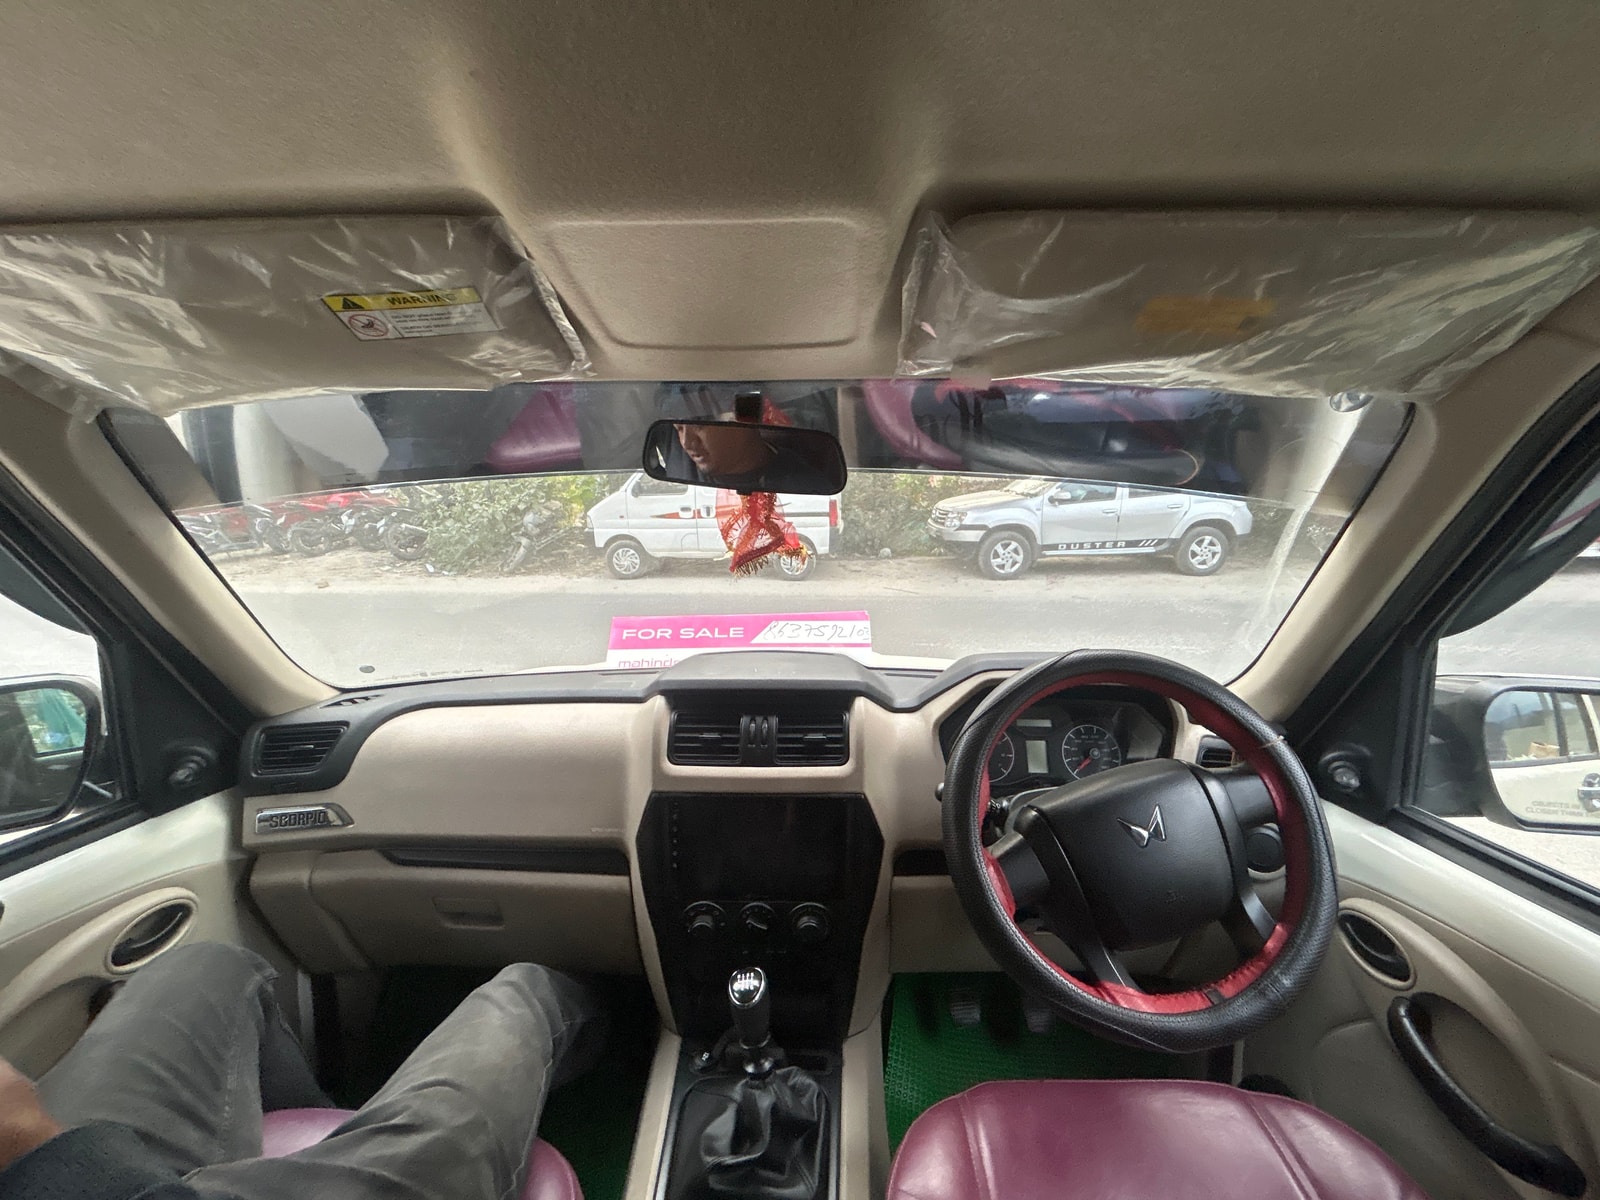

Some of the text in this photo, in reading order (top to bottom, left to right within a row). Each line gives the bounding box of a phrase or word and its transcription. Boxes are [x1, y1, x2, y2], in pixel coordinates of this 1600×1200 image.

[1058, 541, 1126, 550] DUSTER
[622, 627, 745, 640] FOR SALE
[269, 810, 328, 829] SCORPIO
